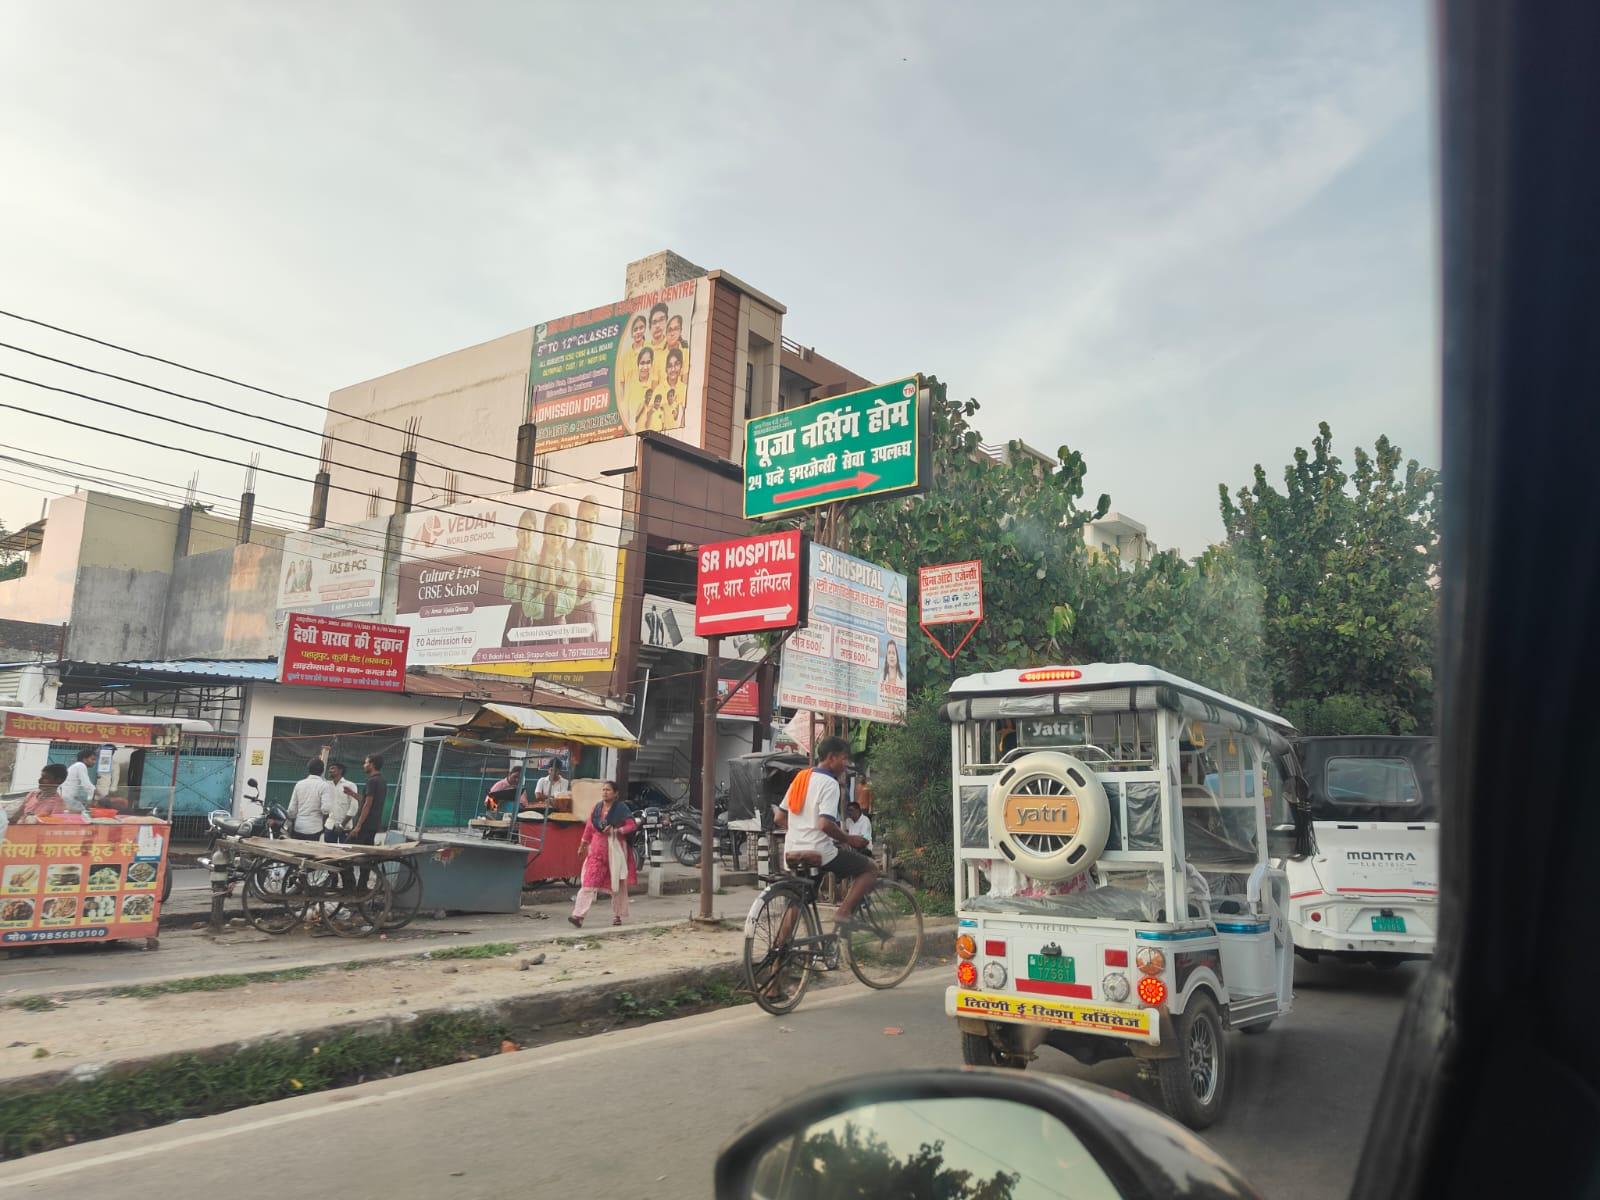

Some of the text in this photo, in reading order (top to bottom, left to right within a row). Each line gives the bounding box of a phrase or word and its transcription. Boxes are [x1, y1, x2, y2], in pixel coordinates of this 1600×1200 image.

[661, 281, 695, 302] CENTRE
[548, 341, 558, 354] TO
[577, 325, 619, 346] CLASSES
[584, 393, 609, 412] OPEN
[755, 428, 796, 467] पूजा
[801, 406, 860, 448] नर्सिंग
[866, 399, 911, 434] होम
[748, 440, 912, 491] 24 घन्टे इमरजेन्सी सेवा उपलब्ध
[448, 511, 496, 533] VEDAM
[470, 531, 496, 542] SCHOOL
[701, 538, 796, 573] SR HOSPITAL
[330, 562, 341, 574] IAS
[352, 559, 367, 571] PCS
[420, 565, 481, 584] Culture First
[818, 551, 834, 576] SR
[834, 555, 885, 592] HOSPITAL
[418, 580, 480, 600] CBSE School
[703, 568, 792, 606] एस. आर. हॉस्पिटल
[293, 624, 318, 644] देशी
[321, 630, 351, 648] शराब
[354, 632, 371, 649] की
[373, 636, 404, 656] दुकान
[416, 635, 472, 647] ₹0 Admission fee
[64, 720, 92, 734] फास्ट
[1016, 804, 1067, 826] yatri
[41, 843, 82, 858] फास्ट
[1347, 851, 1416, 861] MONTRA
[31, 928, 106, 941] 7985680100
[1080, 1010, 1140, 1029] सर्विसेज
